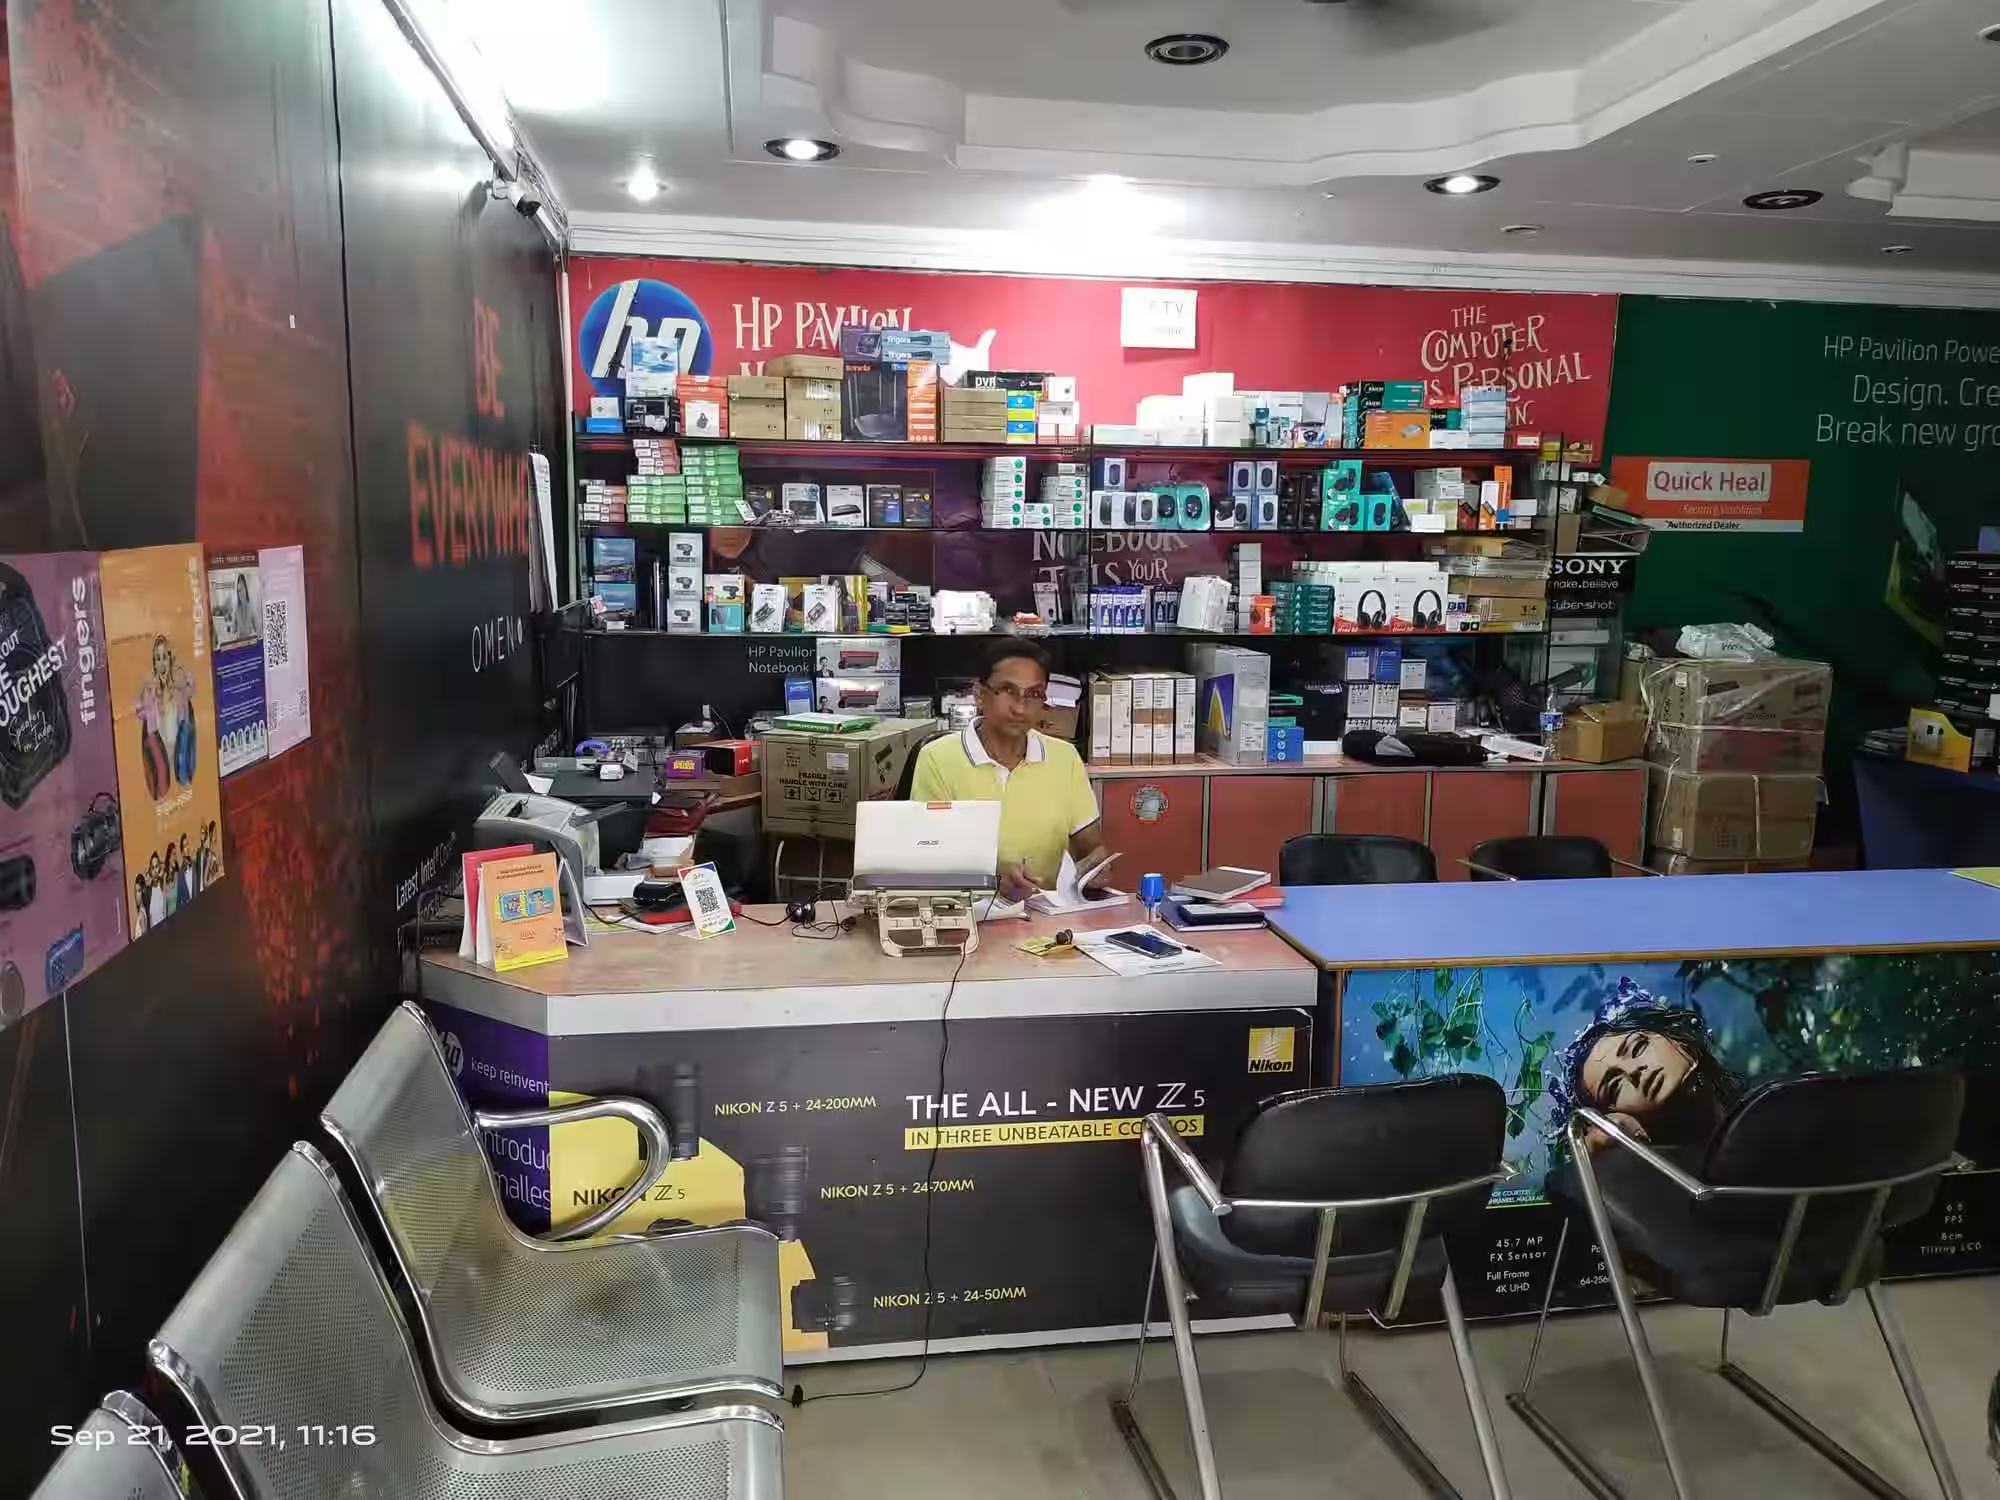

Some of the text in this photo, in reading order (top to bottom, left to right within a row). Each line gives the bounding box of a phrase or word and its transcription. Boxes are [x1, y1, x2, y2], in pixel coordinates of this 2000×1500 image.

[732, 296, 782, 351] HP
[1451, 305, 1487, 329] THE
[1421, 314, 1548, 372] COMPUTER
[1823, 335, 2000, 364] HP Pavilion Powe
[473, 294, 504, 418] BE
[1852, 375, 2000, 411] Design. Cre
[1816, 413, 1892, 443] Break
[1902, 421, 1957, 447] new
[1653, 470, 1766, 493] Quick Heal
[1667, 520, 1741, 530] Authorized Dealer
[1128, 558, 1173, 584] YOUR
[1551, 559, 1627, 576] SONY
[72, 576, 96, 726] fingers
[470, 610, 515, 672] OMEN
[748, 647, 766, 658] HP
[748, 663, 810, 674] Notebook
[395, 867, 419, 911] Latest
[471, 1056, 496, 1080] keep
[1249, 1059, 1292, 1072] Nikon
[713, 1101, 762, 1116] NIKON
[766, 1101, 776, 1113] Z
[779, 1101, 787, 1112] 5
[805, 1095, 877, 1111] 24-200MM
[905, 1093, 968, 1120] THE
[978, 1090, 1037, 1117] ALL
[1069, 1085, 1144, 1113] NEW
[1156, 1082, 1186, 1109] Z
[1193, 1090, 1205, 1108] 5
[911, 1131, 929, 1146] IN
[936, 1128, 992, 1144] THREE
[998, 1122, 1112, 1142] UNBEATABLE
[654, 1185, 673, 1201] Z
[677, 1188, 685, 1200] 5
[820, 1185, 868, 1200] NIKON
[872, 1184, 882, 1196] Z
[886, 1184, 894, 1195] 5
[912, 1179, 975, 1193] 24-70MM
[1496, 1236, 1544, 1248] 45.7 MP
[1960, 1241, 1982, 1252] LCD
[1489, 1251, 1547, 1262] FX Sensor
[1486, 1271, 1530, 1281] Full Frame
[872, 1294, 920, 1309] NIKON
[937, 1292, 945, 1304] 5
[963, 1287, 1027, 1302] 24-50MM
[1495, 1283, 1530, 1294] 4K UHD
